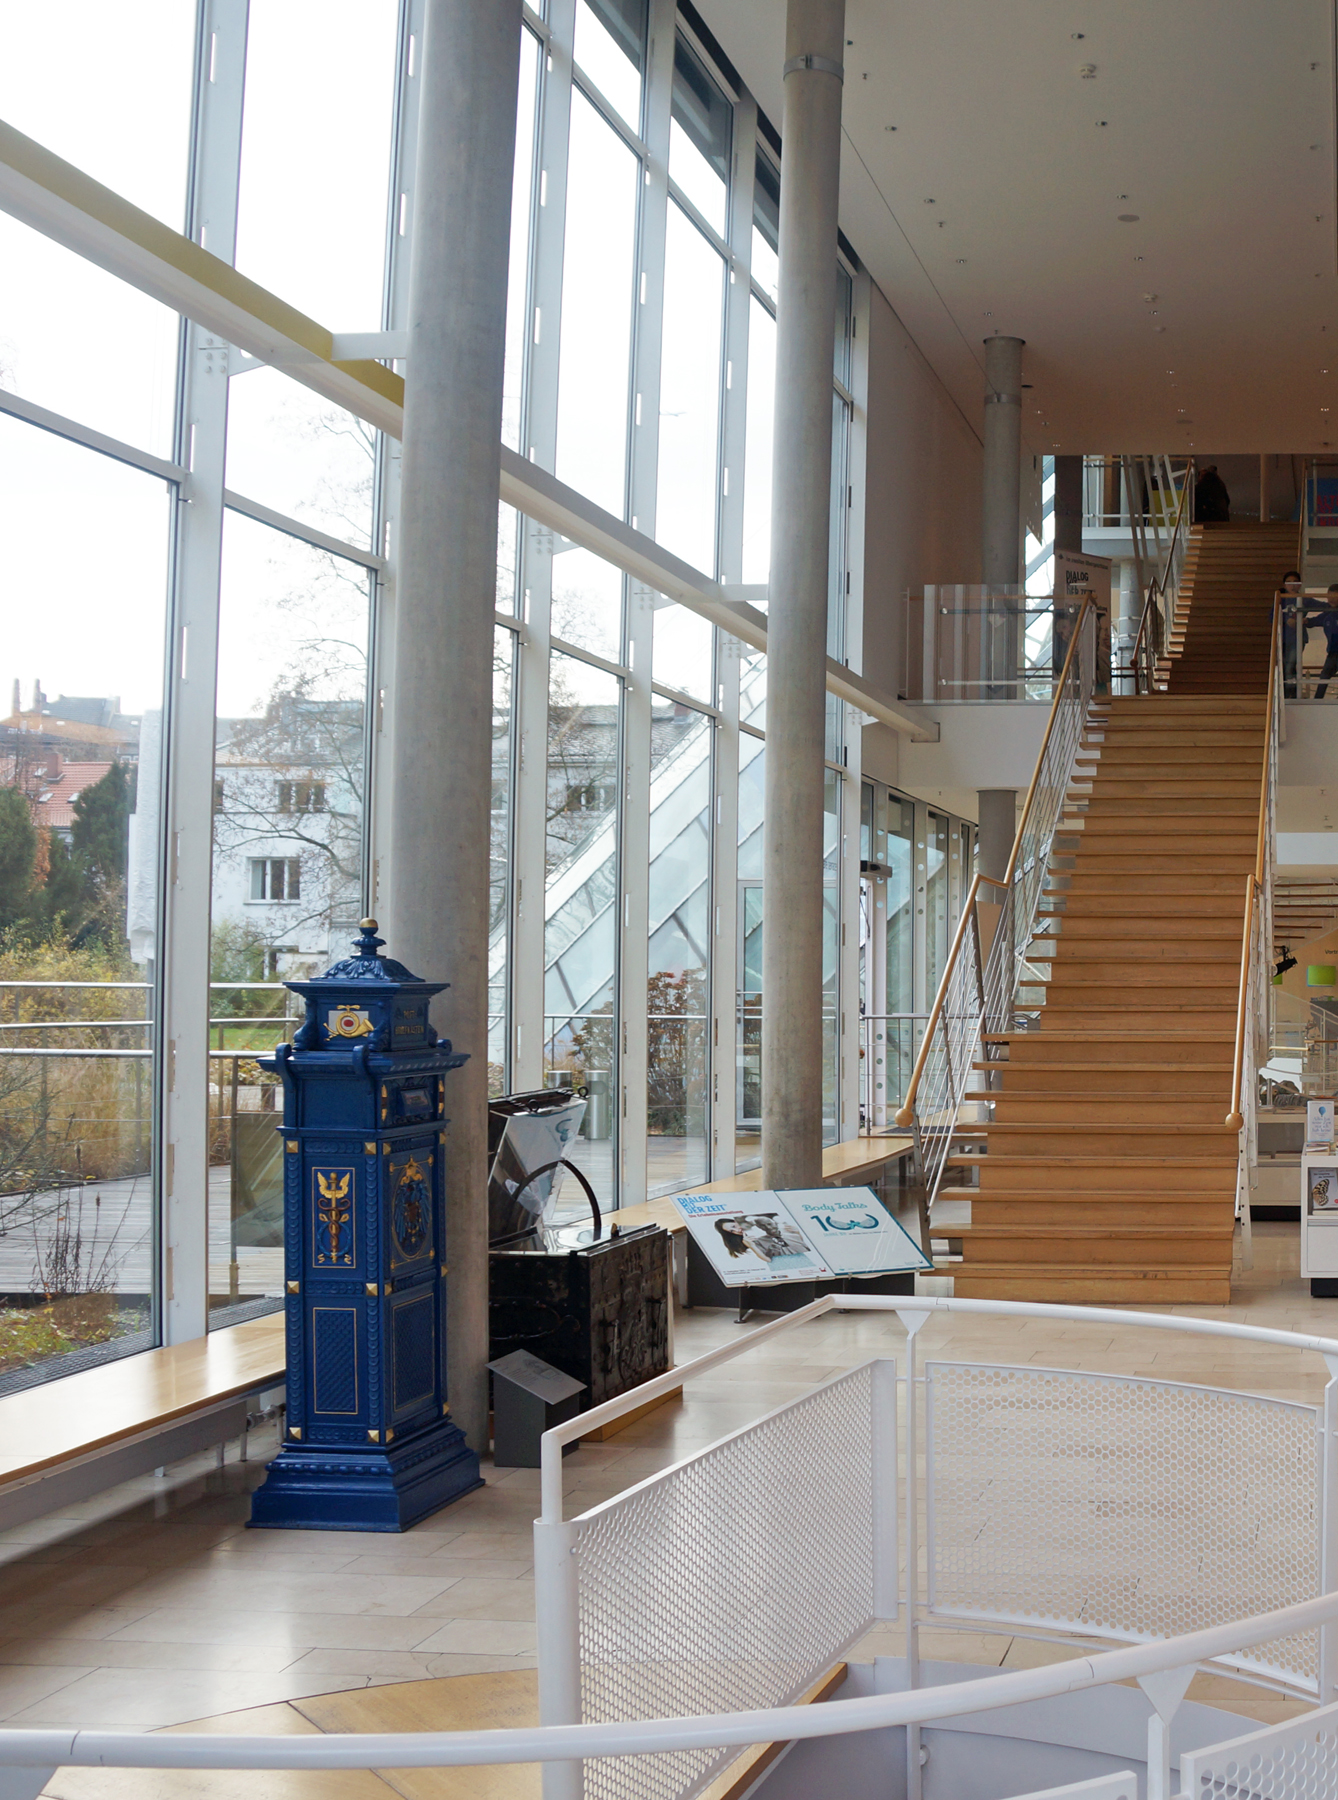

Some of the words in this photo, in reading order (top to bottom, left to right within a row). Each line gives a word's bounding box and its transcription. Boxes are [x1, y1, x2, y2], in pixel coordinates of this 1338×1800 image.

[1065, 570, 1089, 581] DIALOG
[677, 1195, 713, 1205] DIALOG
[685, 1206, 706, 1214] DER
[705, 1204, 727, 1212] ZEIT
[802, 1203, 836, 1213] Body
[834, 1202, 868, 1210] Talks
